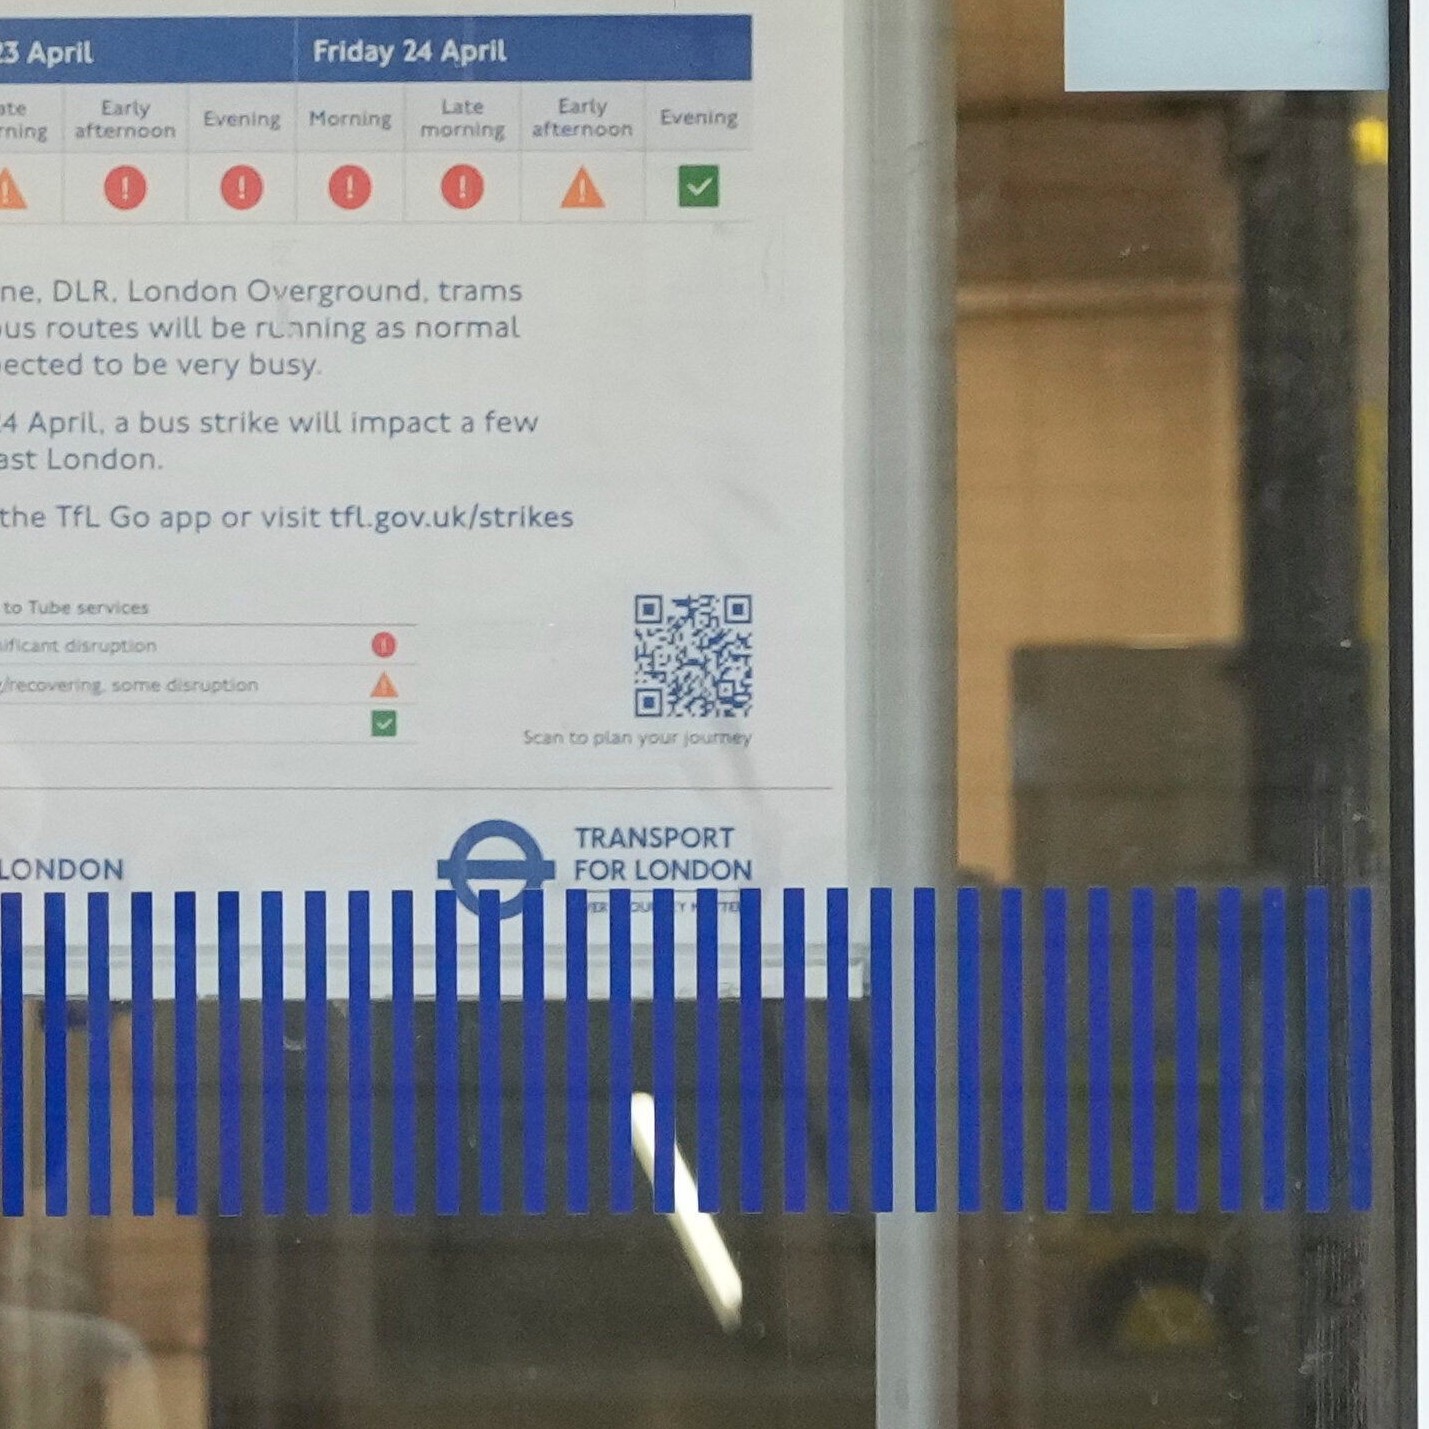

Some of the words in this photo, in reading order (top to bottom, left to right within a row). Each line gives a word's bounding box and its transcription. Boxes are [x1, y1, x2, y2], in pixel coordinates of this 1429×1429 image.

[27, 41, 93, 68] April
[314, 39, 394, 67] Friday
[403, 39, 432, 62] 24
[441, 39, 507, 67] April
[102, 99, 150, 120] Early
[441, 98, 485, 116] Late
[559, 97, 607, 118] Early
[204, 110, 281, 131] Evening
[309, 110, 392, 131] Morning
[531, 120, 634, 138] afternoon
[660, 108, 739, 130] Evening
[74, 121, 177, 140] afternoon
[420, 121, 506, 143] morning
[53, 279, 116, 303] DLR,
[129, 279, 236, 302] London
[247, 279, 428, 308] Overground,
[438, 281, 522, 302] trams
[46, 318, 139, 340] routes
[149, 316, 202, 339] will
[212, 316, 246, 339] be
[375, 320, 406, 340] as
[416, 315, 520, 338] normal
[92, 355, 124, 377] to
[134, 353, 167, 375] be
[177, 358, 239, 381] very
[250, 353, 321, 381] busy.
[28, 411, 104, 439] April,
[114, 415, 129, 434] a
[140, 411, 190, 434] bus
[200, 411, 278, 433] strike
[289, 411, 341, 433] will
[352, 412, 451, 439] impact
[460, 415, 475, 434] a
[485, 410, 538, 433] few
[48, 448, 162, 470] London.
[0, 506, 46, 528] the
[56, 505, 100, 528] TfL
[110, 505, 150, 528] Go
[160, 511, 211, 533] app
[221, 510, 253, 529] or
[261, 507, 320, 528] visit
[330, 503, 574, 534] tfl.gov.uk/strikes
[2, 601, 23, 615] to
[27, 599, 72, 616] Tube
[76, 601, 150, 616] services
[64, 638, 158, 656] disruption
[111, 680, 162, 693] some
[164, 677, 259, 695] disruption
[523, 729, 565, 746] Scan
[568, 731, 589, 746] to
[592, 730, 633, 748] plan
[637, 732, 679, 749] your
[575, 827, 735, 848] TRANSPORT
[575, 859, 626, 881] FOR
[635, 859, 752, 881] LONDON
